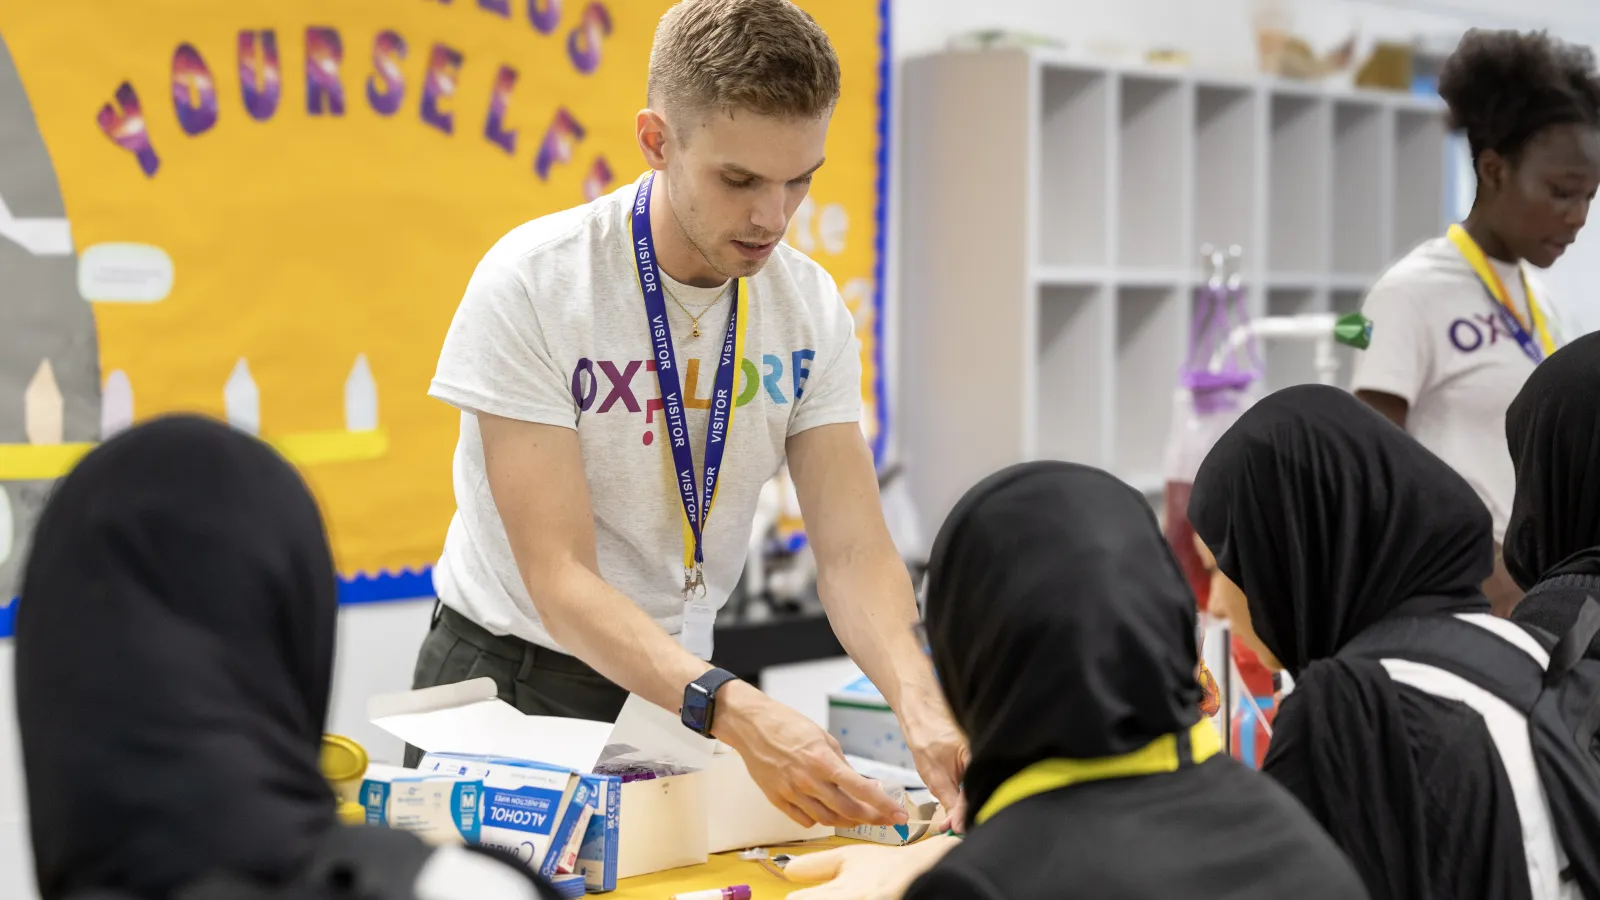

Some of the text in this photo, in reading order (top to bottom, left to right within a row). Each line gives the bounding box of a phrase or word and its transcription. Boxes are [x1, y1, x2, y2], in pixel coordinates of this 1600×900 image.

[637, 237, 657, 293] VISITOR
[652, 314, 671, 371] VISITOR
[666, 392, 685, 448] VISITOR
[711, 389, 728, 444] VISITOR
[680, 469, 697, 522] VISITOR
[703, 466, 717, 520] VISITOR
[368, 791, 382, 807] M
[462, 793, 475, 808] M
[490, 806, 548, 828] ALCOHOL
